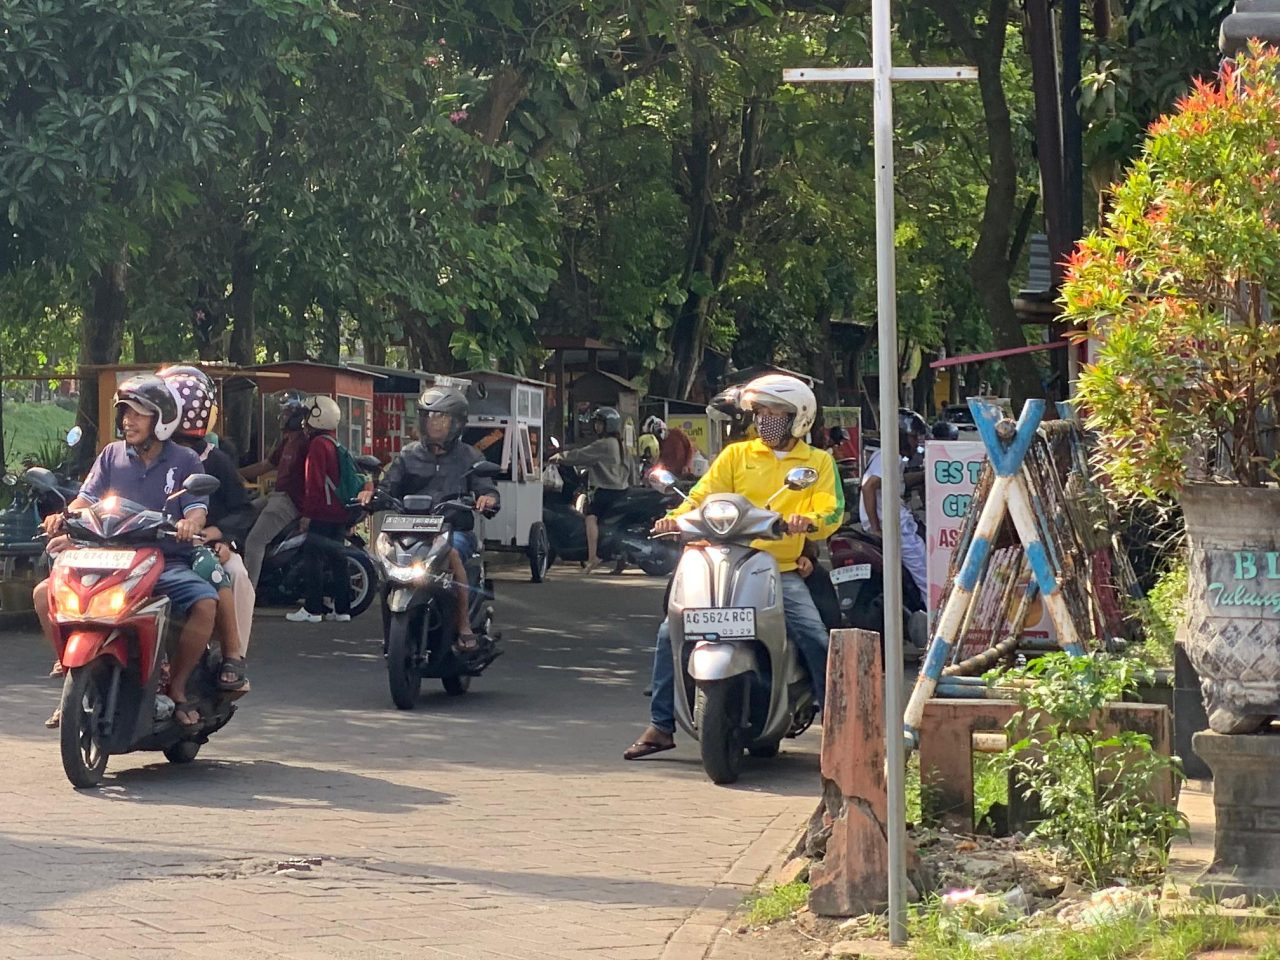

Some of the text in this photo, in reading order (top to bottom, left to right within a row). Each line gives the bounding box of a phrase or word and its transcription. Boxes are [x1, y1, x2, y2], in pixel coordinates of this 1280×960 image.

[934, 460, 964, 485] ES
[686, 613, 699, 624] AG
[702, 611, 730, 623] 5624
